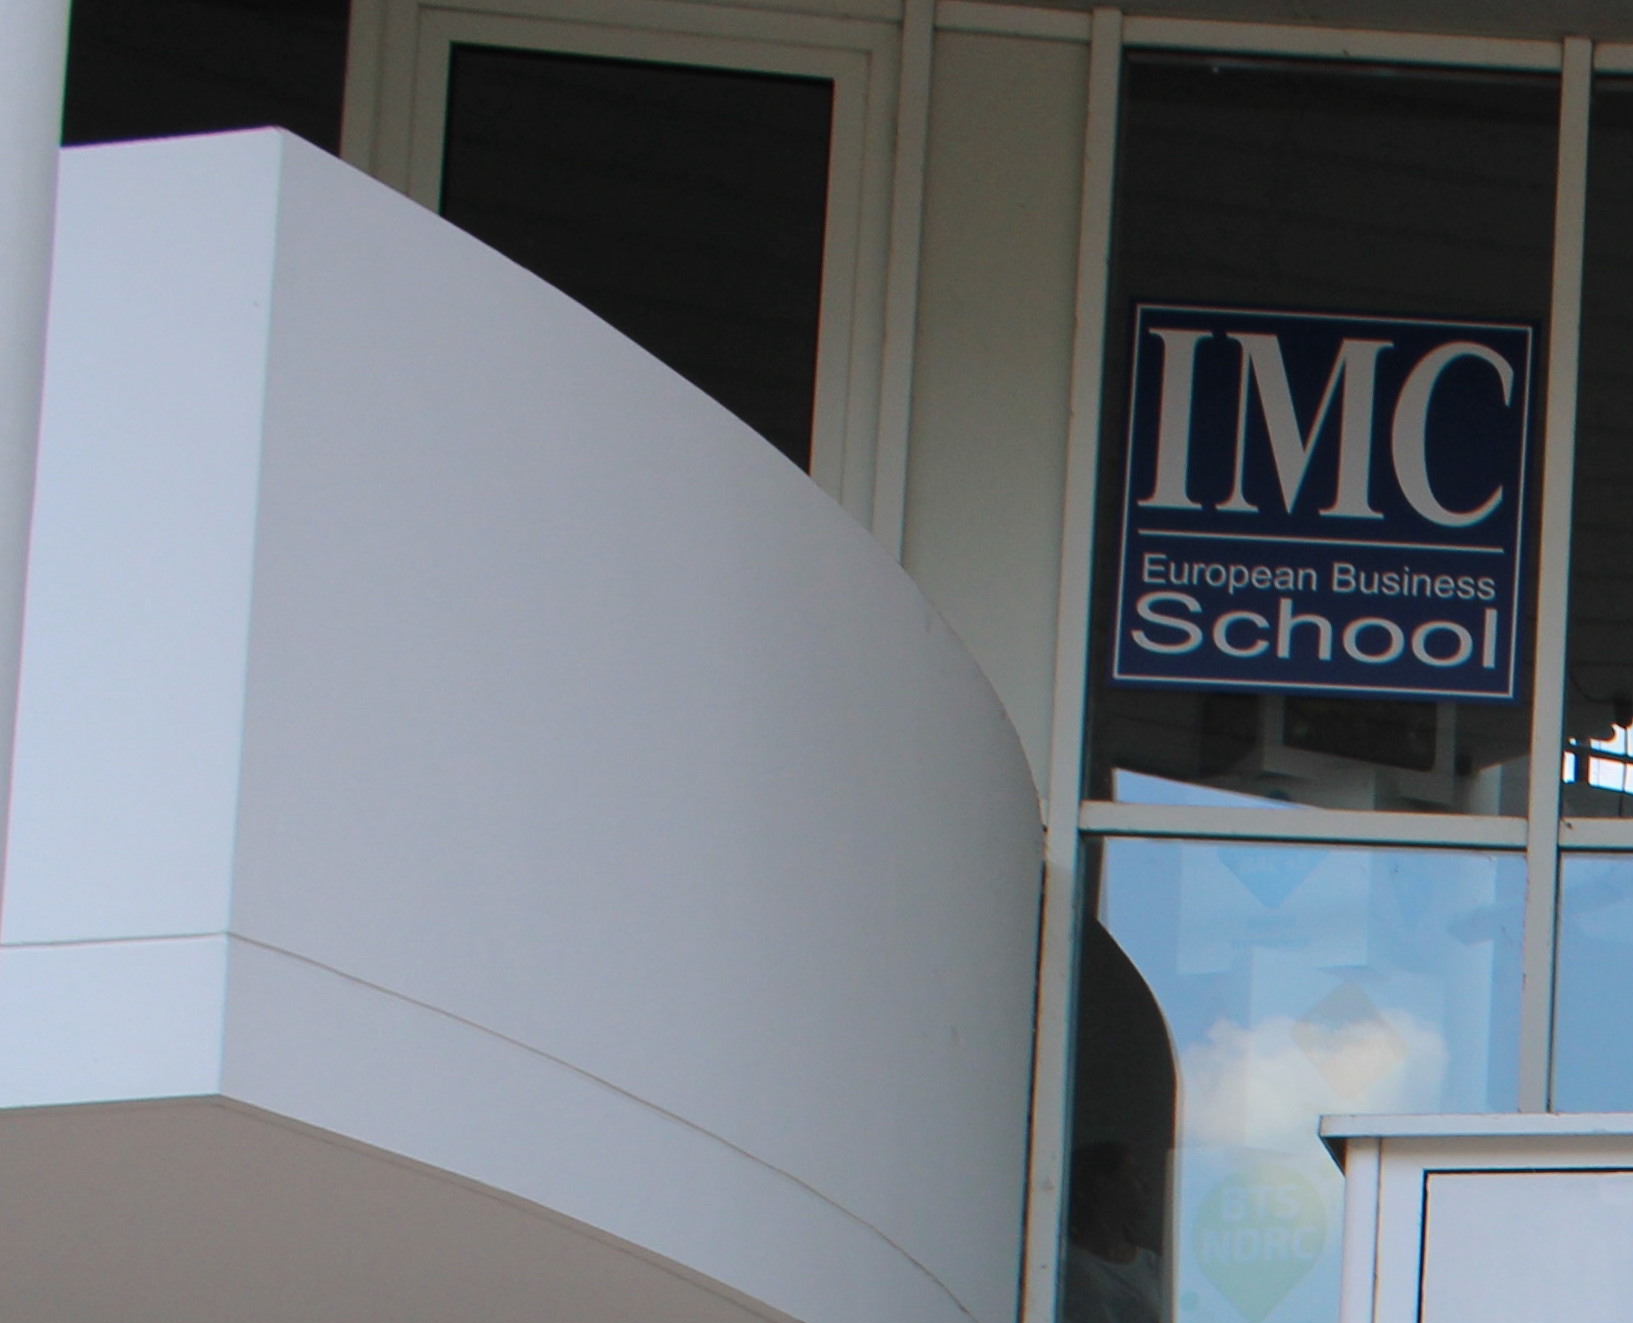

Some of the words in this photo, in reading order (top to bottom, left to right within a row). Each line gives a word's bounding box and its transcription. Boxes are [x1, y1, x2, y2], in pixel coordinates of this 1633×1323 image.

[1137, 327, 1515, 529] IMC
[1141, 553, 1317, 597] European
[1331, 561, 1497, 601] Business
[1131, 591, 1498, 670] School
